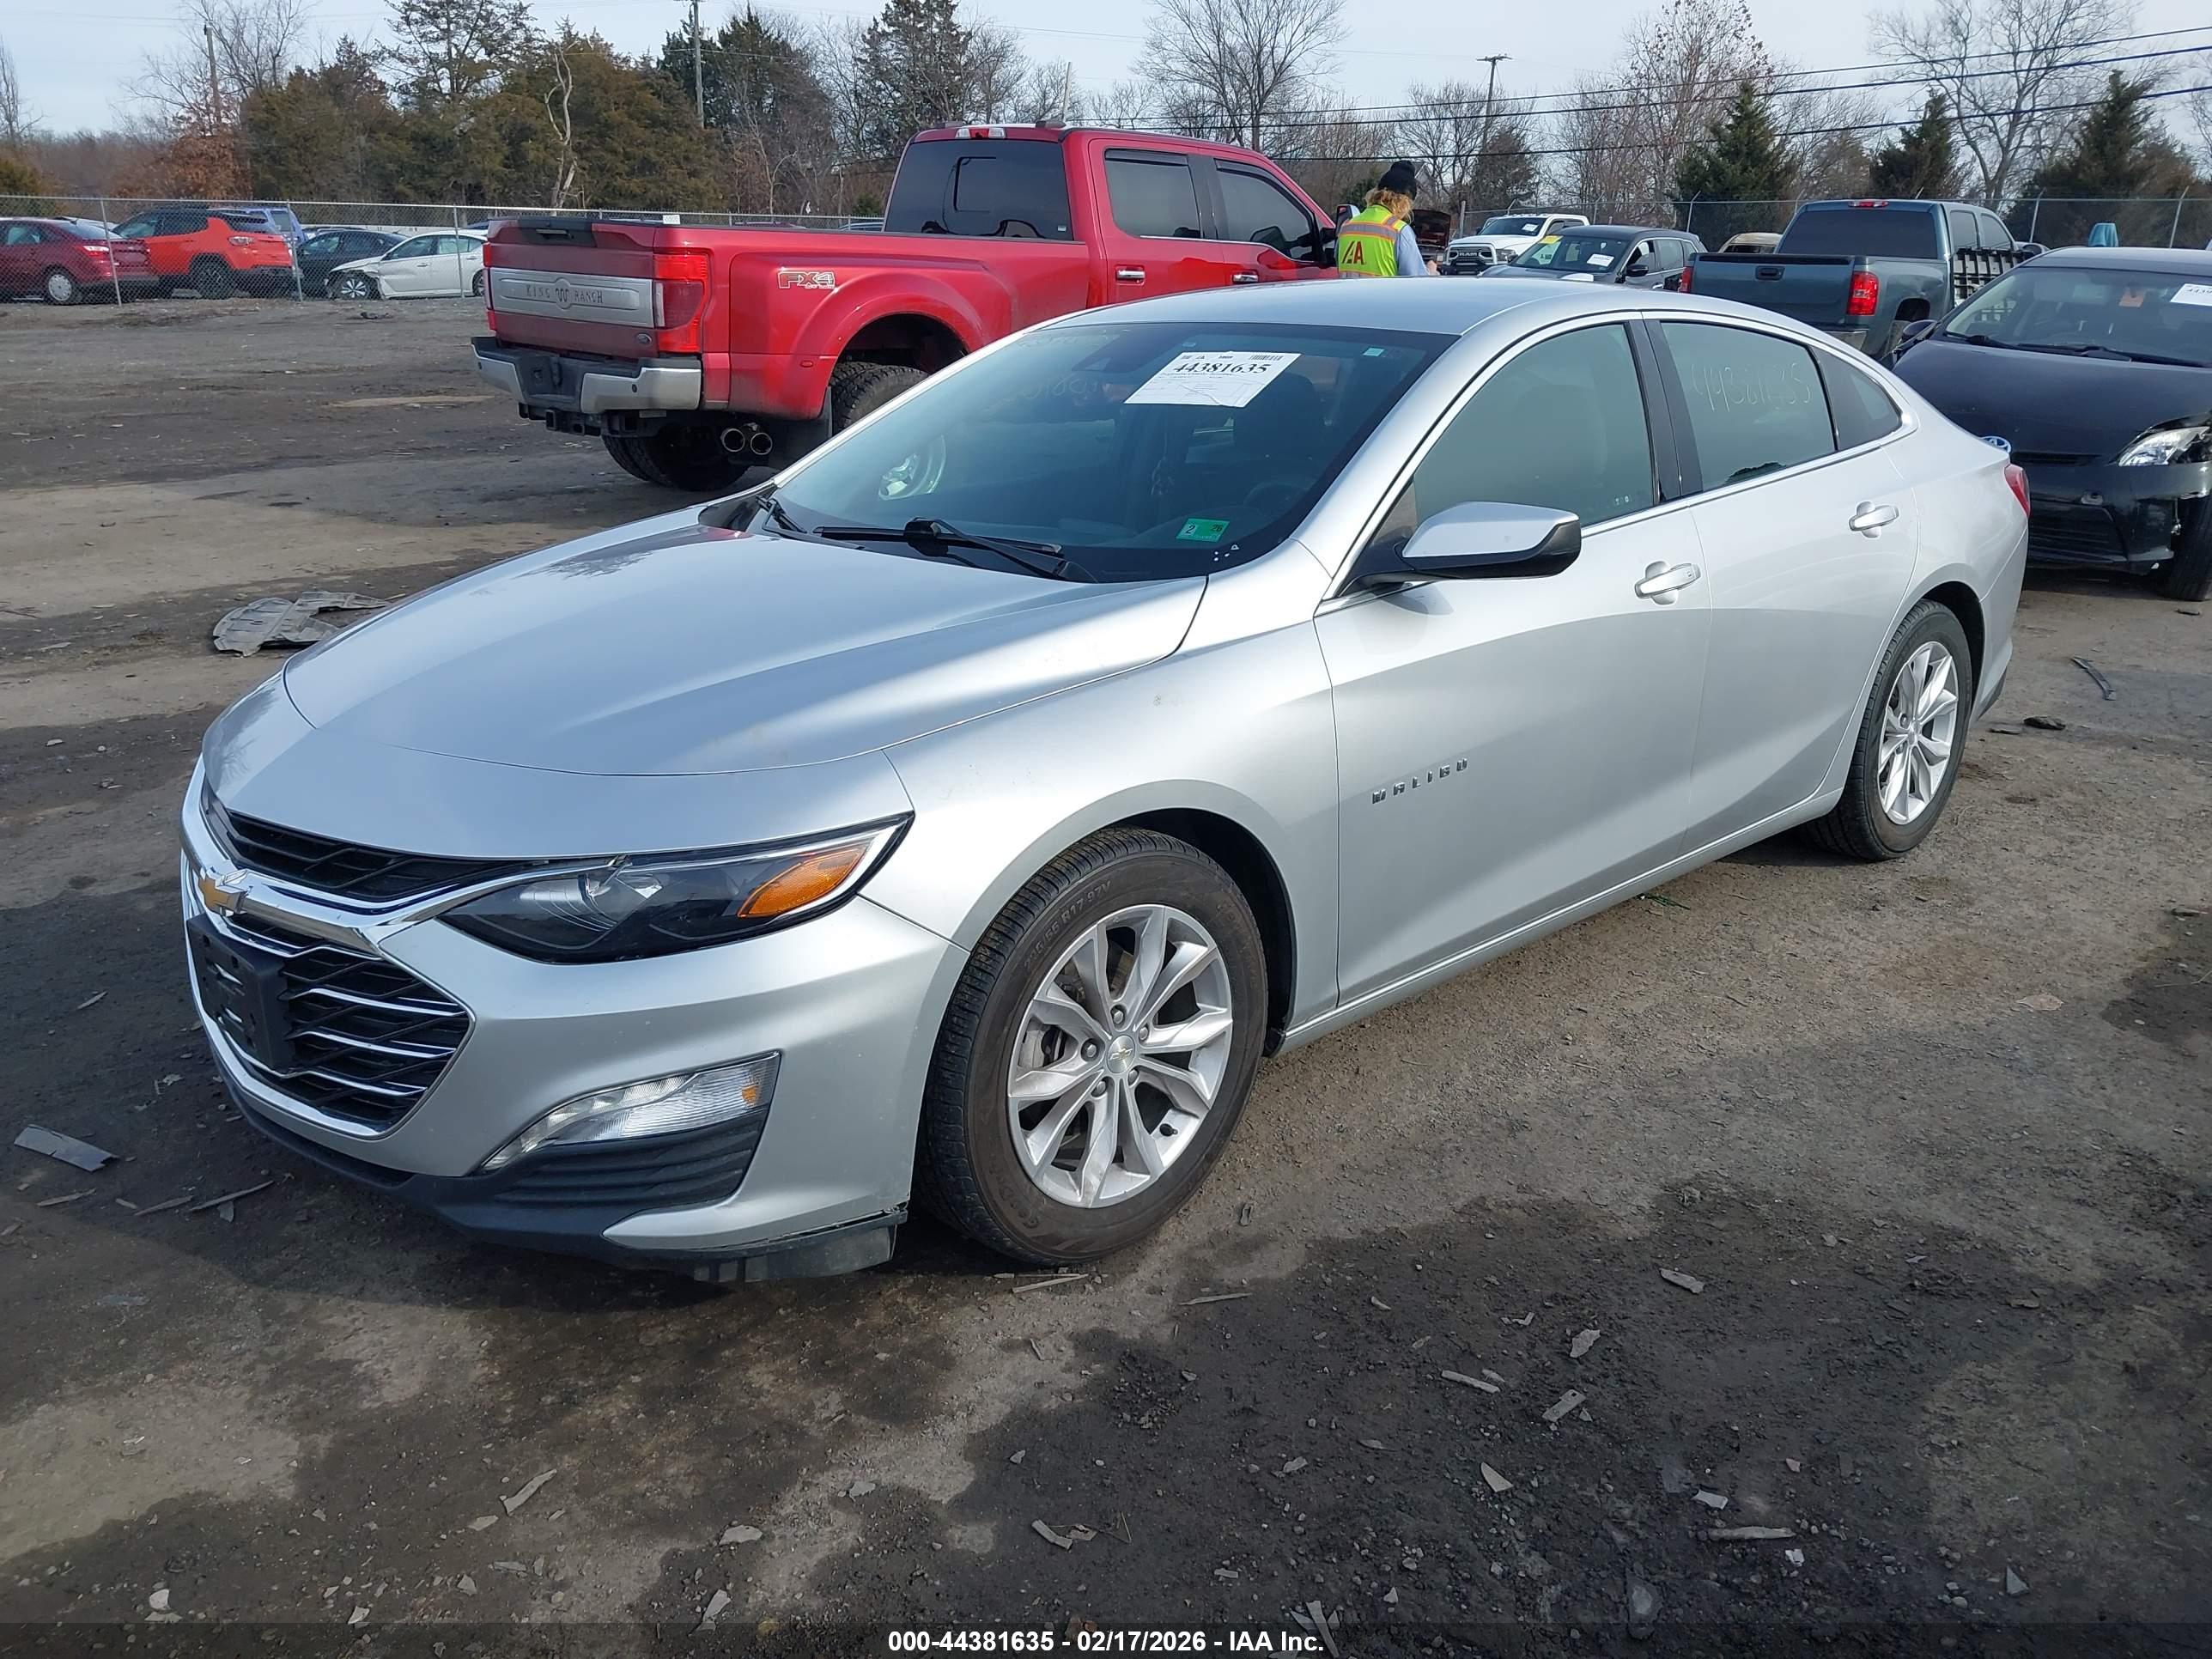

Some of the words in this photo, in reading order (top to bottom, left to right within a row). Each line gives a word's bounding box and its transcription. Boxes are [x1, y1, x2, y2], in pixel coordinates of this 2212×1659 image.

[777, 271, 836, 289] FX4
[1173, 362, 1272, 374] 44381635
[1691, 362, 1812, 412] 4438135
[1185, 525, 1196, 534] 2
[1371, 757, 1468, 805] MALIBU
